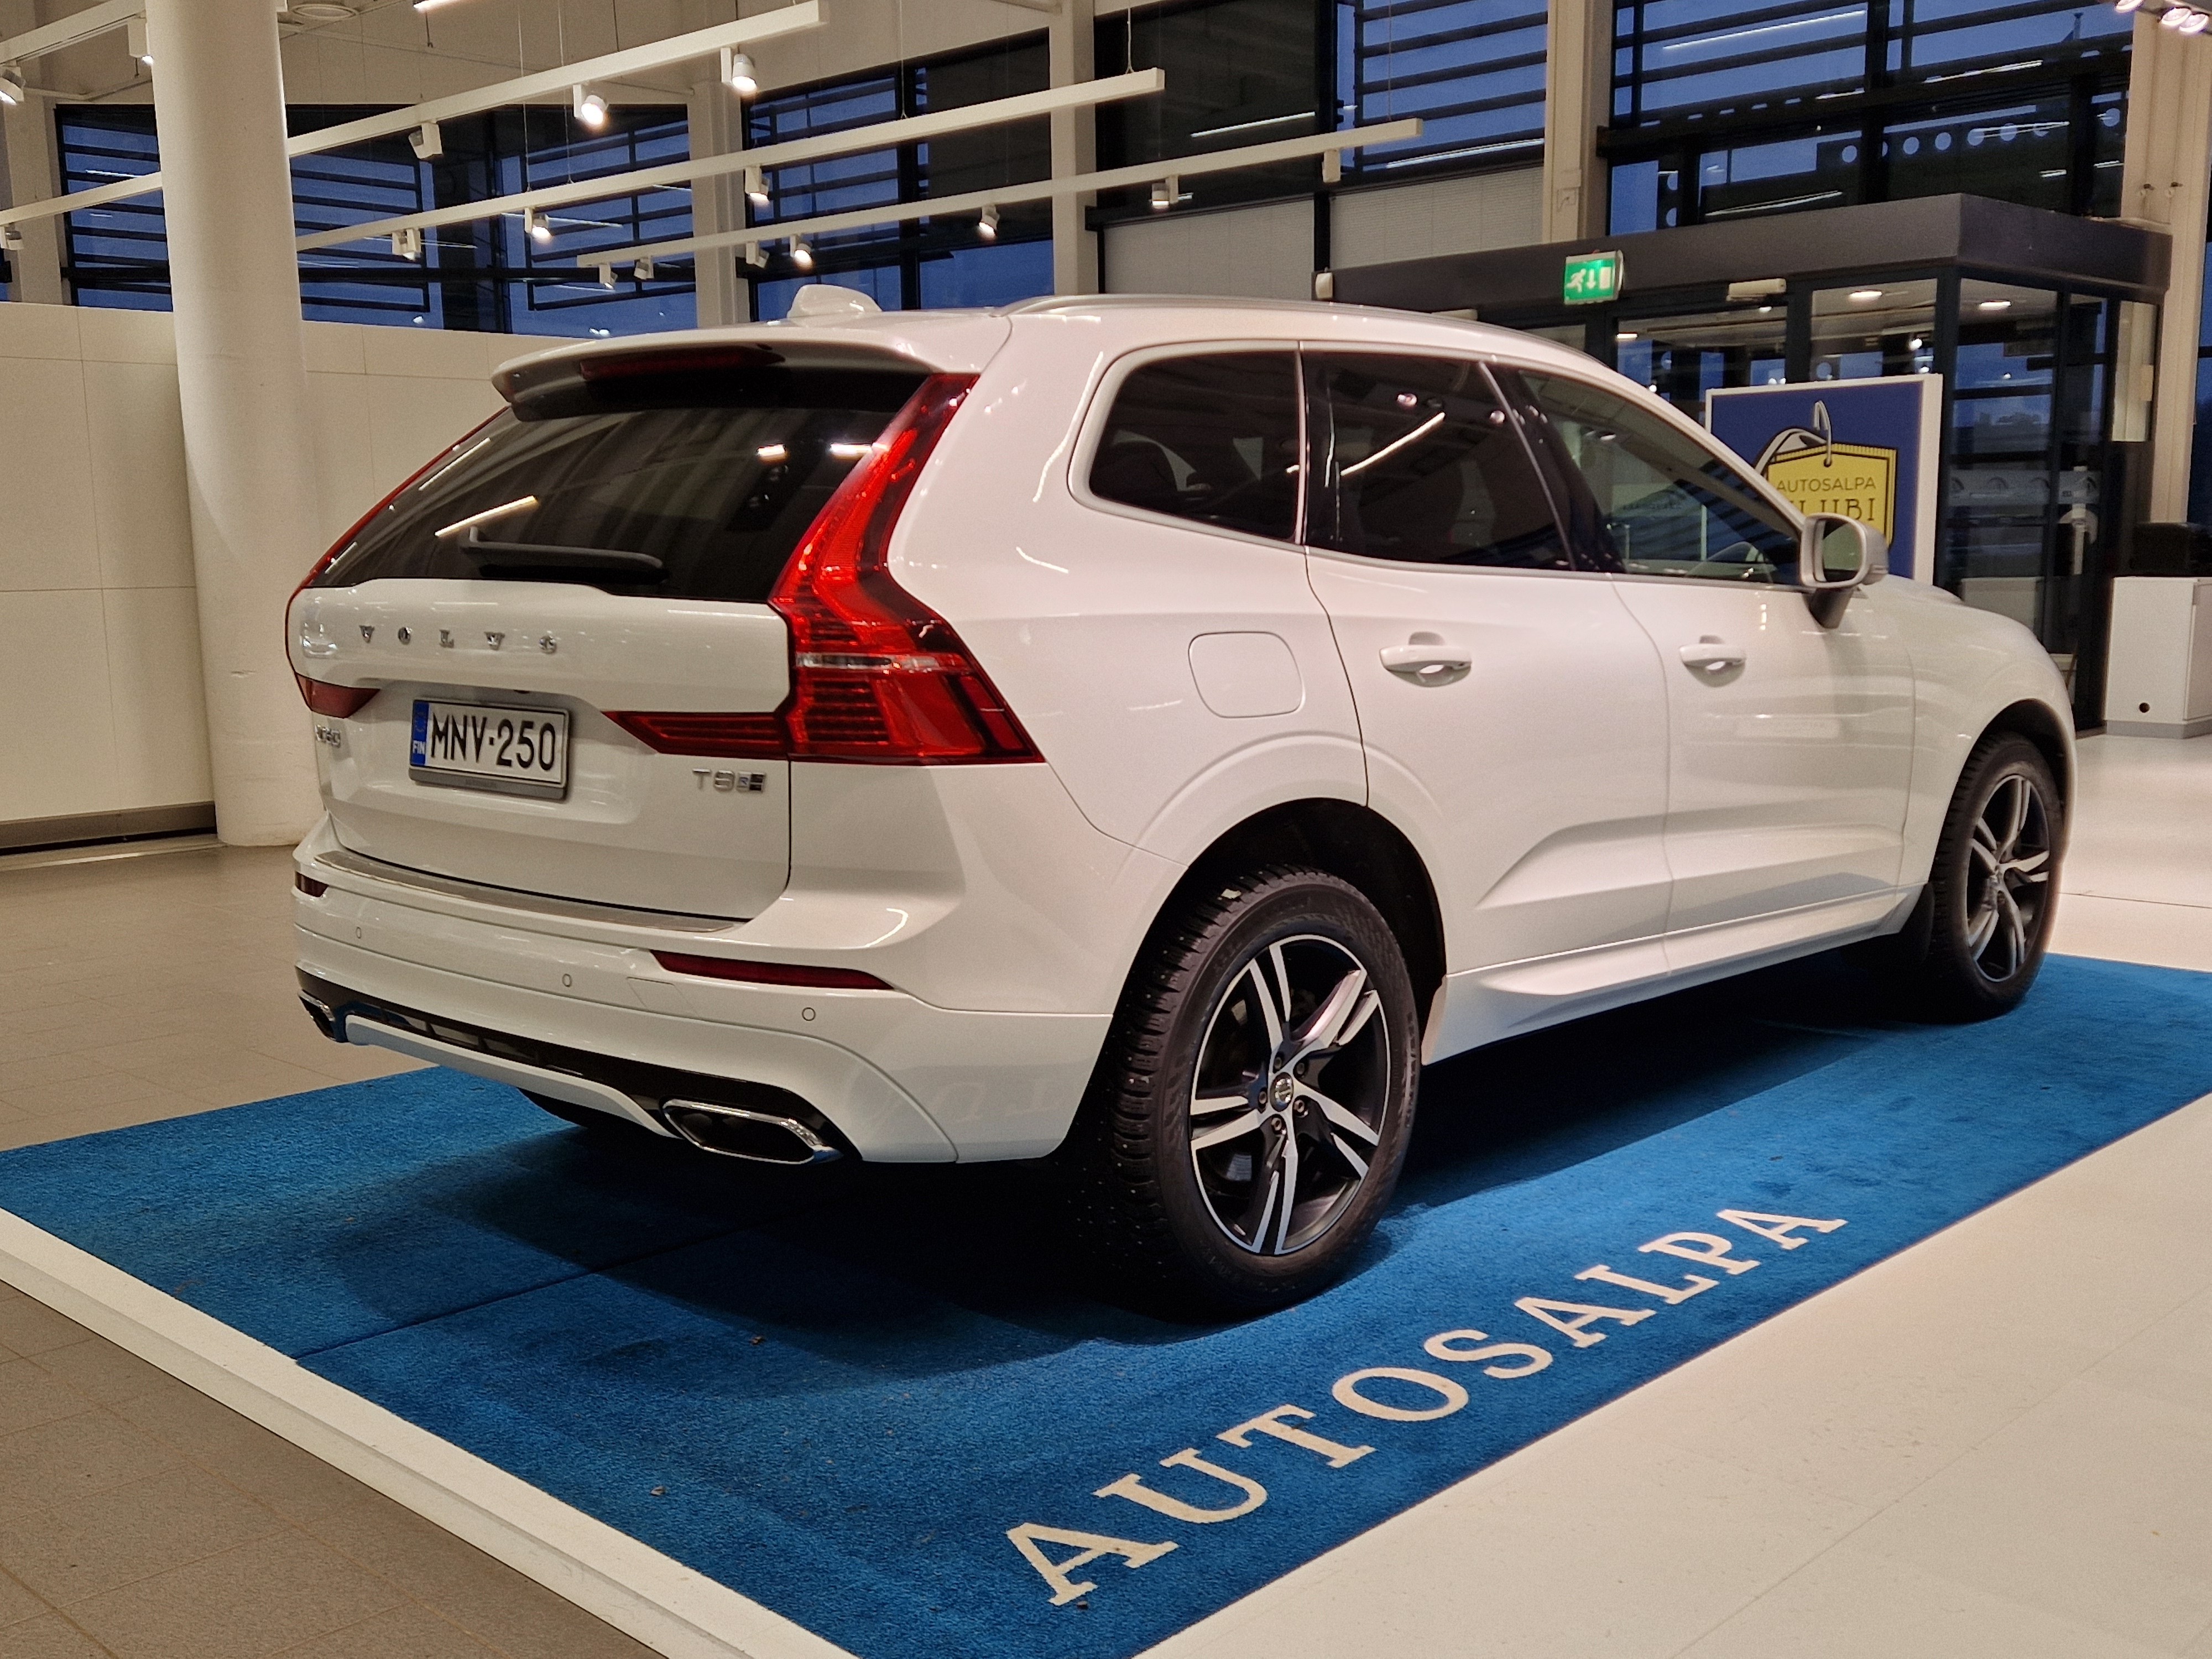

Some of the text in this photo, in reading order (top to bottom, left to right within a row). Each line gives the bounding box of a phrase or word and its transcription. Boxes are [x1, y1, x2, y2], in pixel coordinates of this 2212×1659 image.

[1777, 476, 1876, 493] AUTOSALPA
[1790, 498, 1875, 521] LUBI
[359, 625, 557, 655] VOLVO
[412, 739, 426, 755] FIN
[431, 711, 556, 771] MNV-250
[1007, 1209, 1847, 1605] AUTOSALPA
